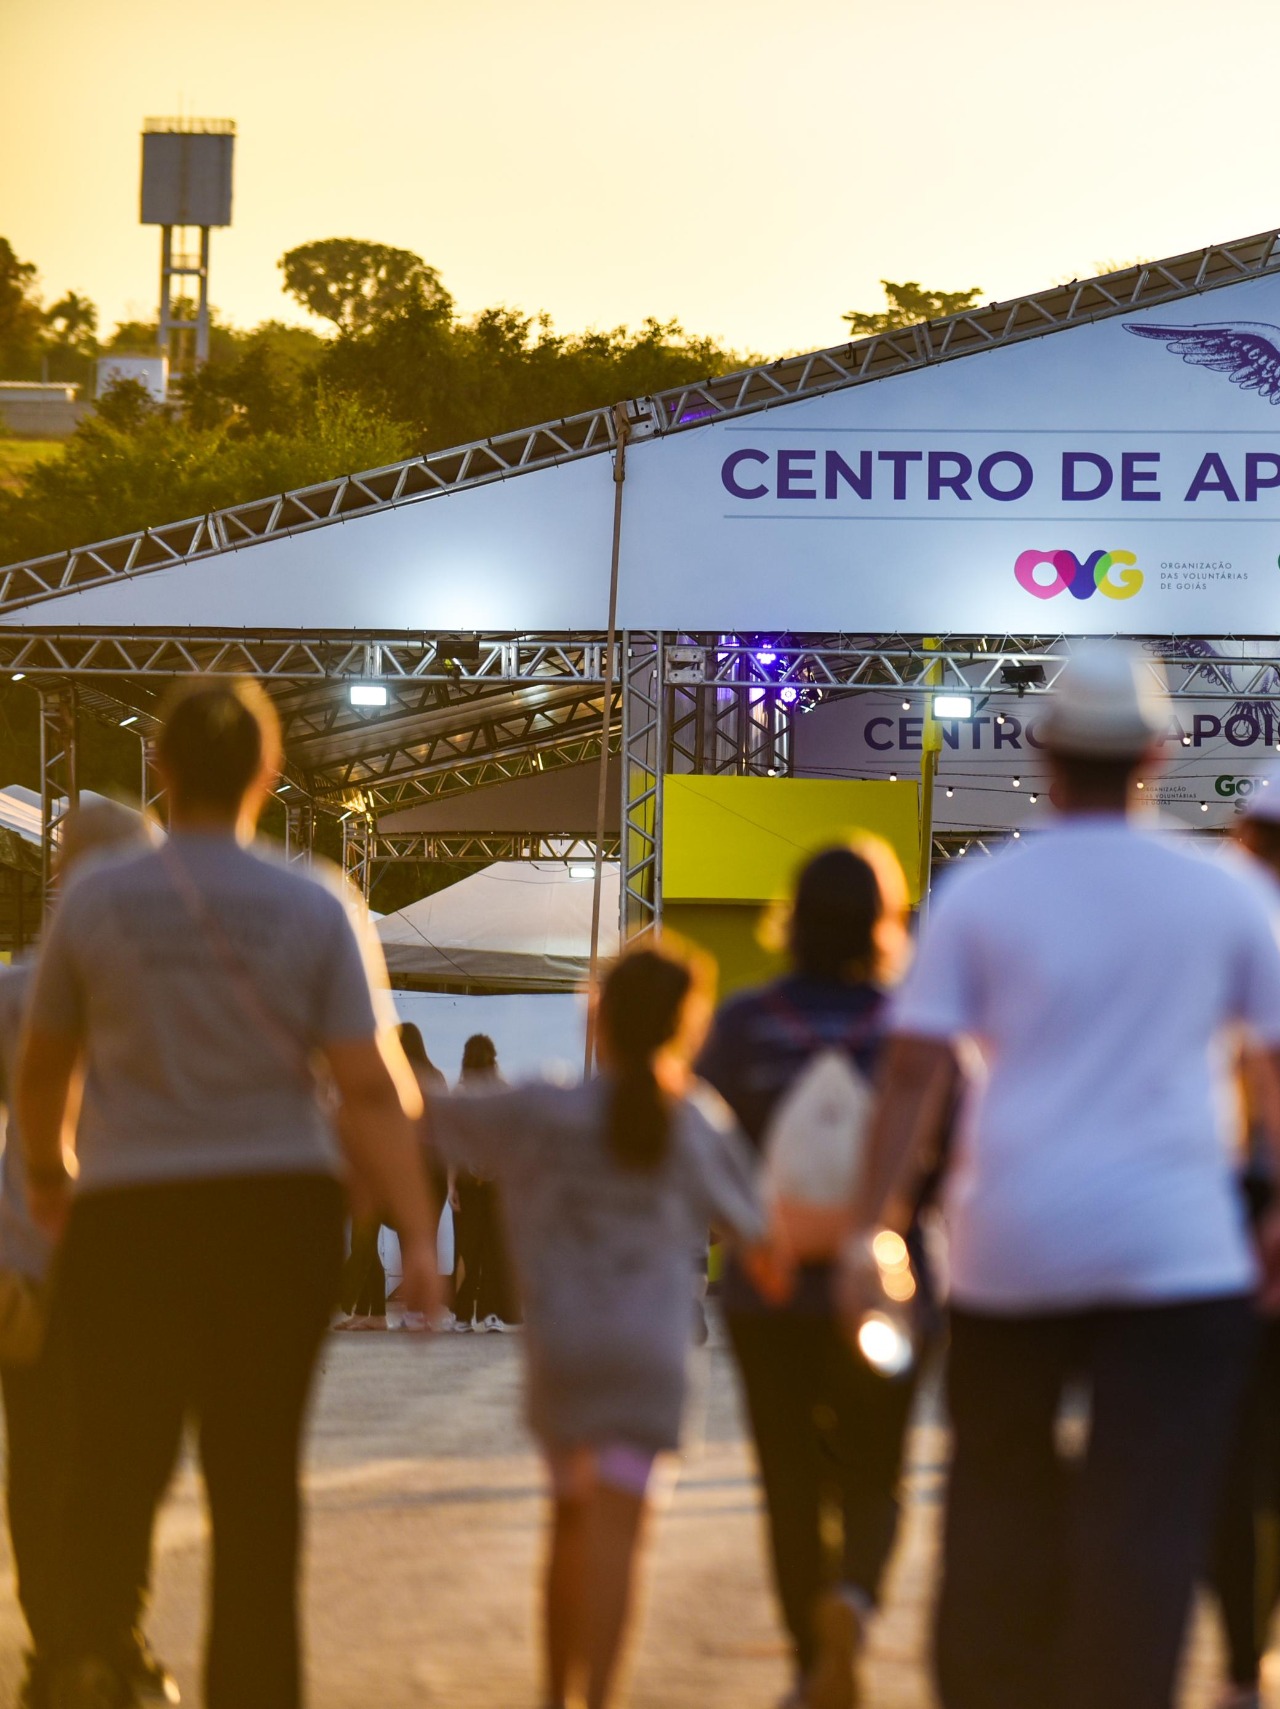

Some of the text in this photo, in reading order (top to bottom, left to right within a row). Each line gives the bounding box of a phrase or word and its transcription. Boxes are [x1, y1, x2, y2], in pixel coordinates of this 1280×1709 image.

[721, 448, 1034, 502] CENTRO
[1062, 451, 1161, 502] DE
[1160, 561, 1233, 571] ORGANIZAÇÃO
[1013, 549, 1145, 600] OVG
[1160, 571, 1249, 580] DAS VOLUNTÁRIAS
[1176, 581, 1208, 590] GOIÁS
